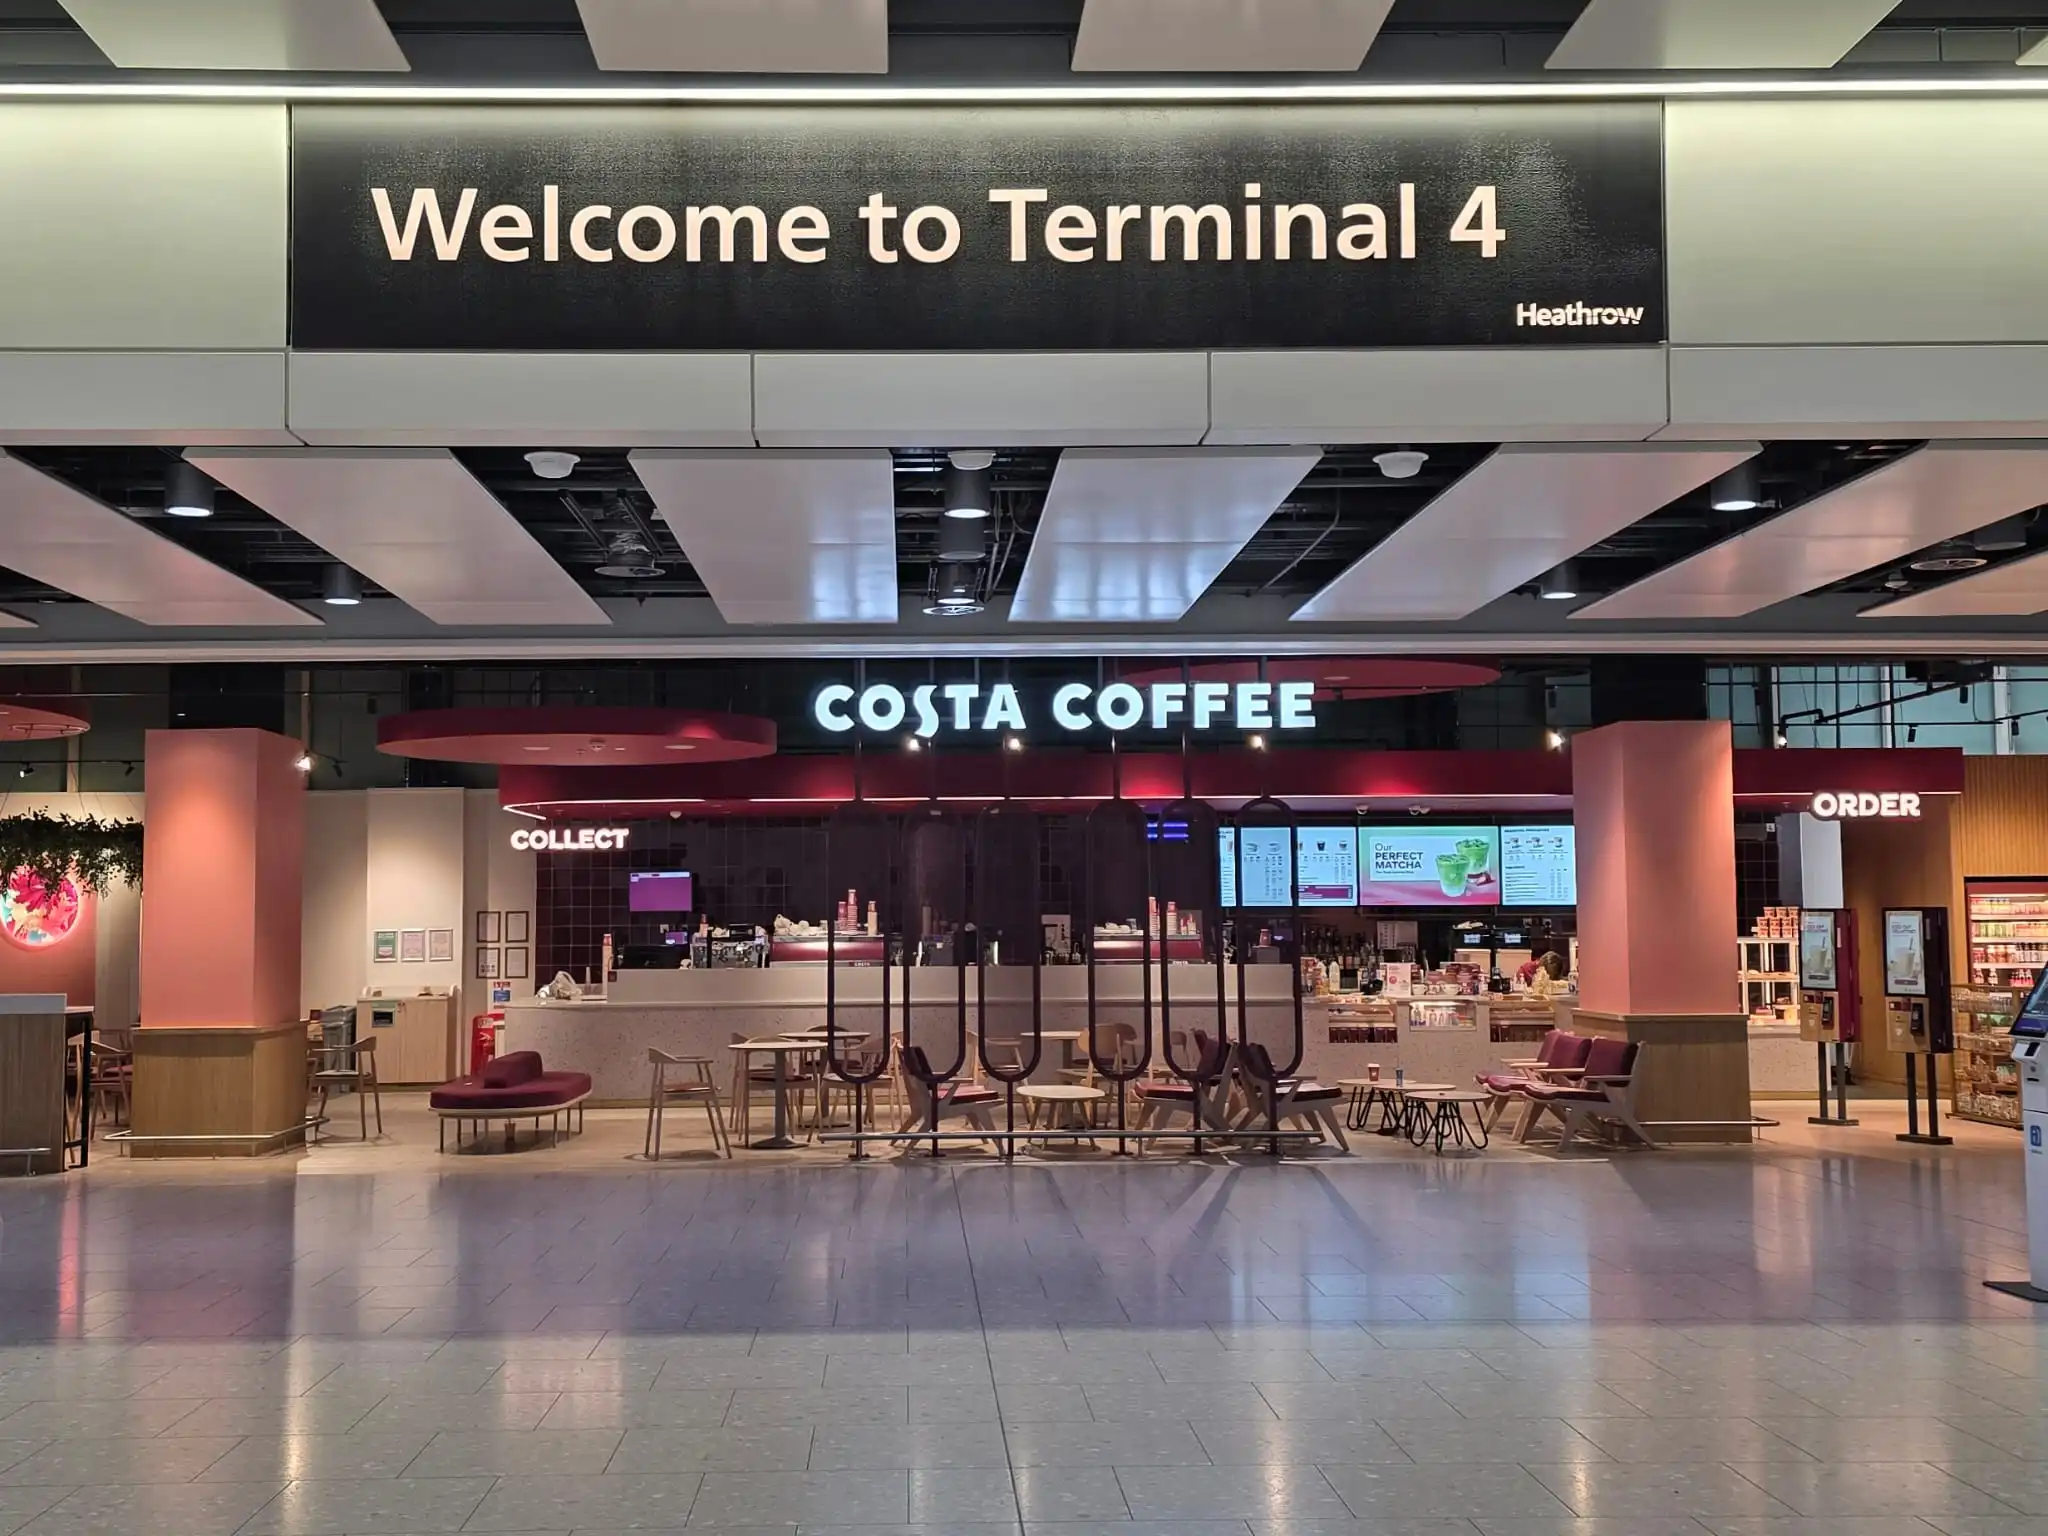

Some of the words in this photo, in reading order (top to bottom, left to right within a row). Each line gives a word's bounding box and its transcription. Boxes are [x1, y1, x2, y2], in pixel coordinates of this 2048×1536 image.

[370, 184, 830, 264] Welcome
[858, 192, 961, 264] to
[988, 182, 1417, 263] Terminal
[1449, 185, 1506, 259] 4
[1515, 300, 1645, 327] Heathrow
[815, 683, 1027, 738] COSTA
[1052, 681, 1316, 731] COFFEE
[1813, 792, 1921, 818] ORDER
[510, 828, 630, 851] COLLECT
[1374, 842, 1393, 852] Our
[1374, 851, 1424, 861] PERFECT
[1374, 860, 1423, 870] MATCHA
